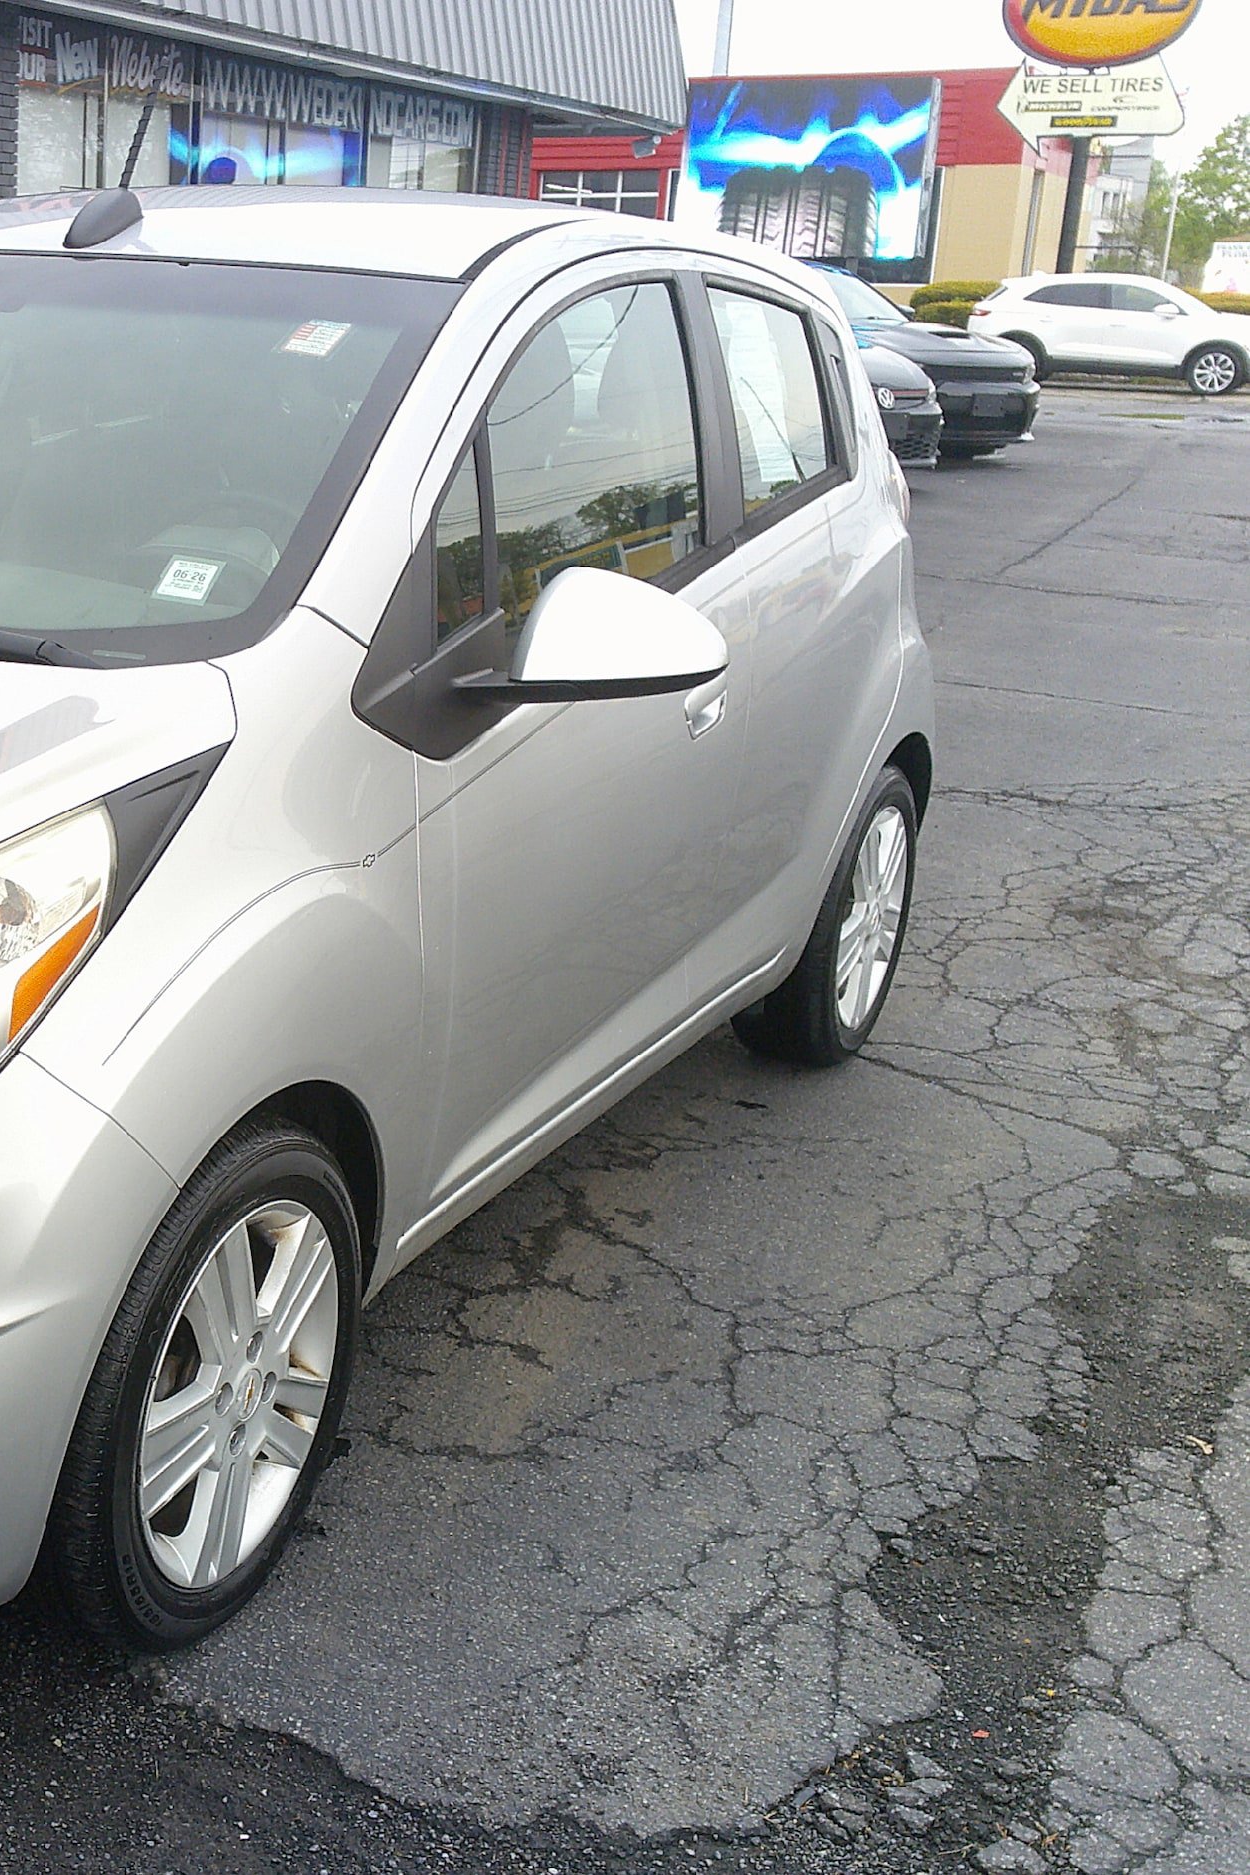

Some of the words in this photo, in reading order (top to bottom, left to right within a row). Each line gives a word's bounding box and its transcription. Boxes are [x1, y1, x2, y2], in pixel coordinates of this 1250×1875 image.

[1023, 79, 1052, 93] WE
[1057, 78, 1103, 93] SELL
[1110, 77, 1164, 92] TIRES
